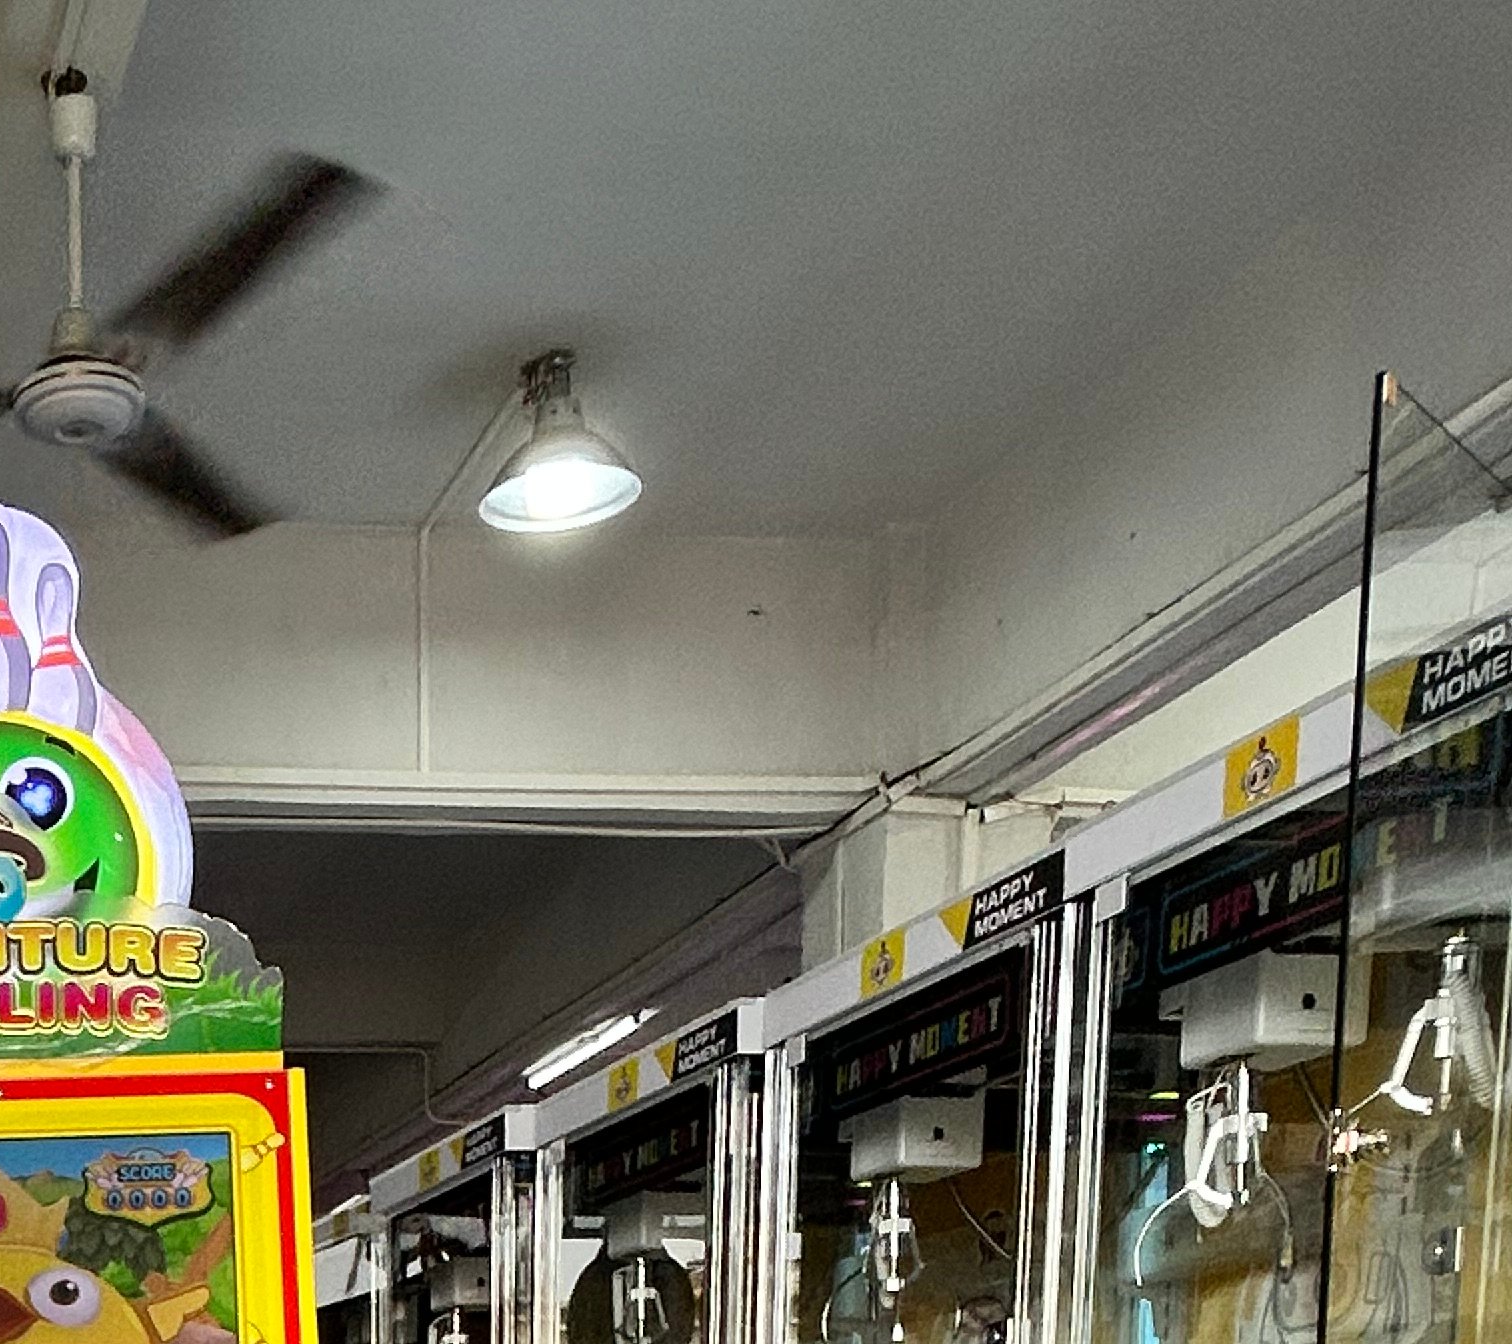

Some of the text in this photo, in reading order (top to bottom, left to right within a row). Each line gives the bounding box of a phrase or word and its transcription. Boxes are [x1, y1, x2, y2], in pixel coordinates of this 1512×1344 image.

[1422, 618, 1512, 684] HAPP
[1421, 650, 1512, 714] MOME
[974, 886, 1048, 938] MOMENT
[975, 870, 1034, 916] HAPPY
[1169, 871, 1278, 954] HAPPY
[119, 1164, 173, 1180] SCORE
